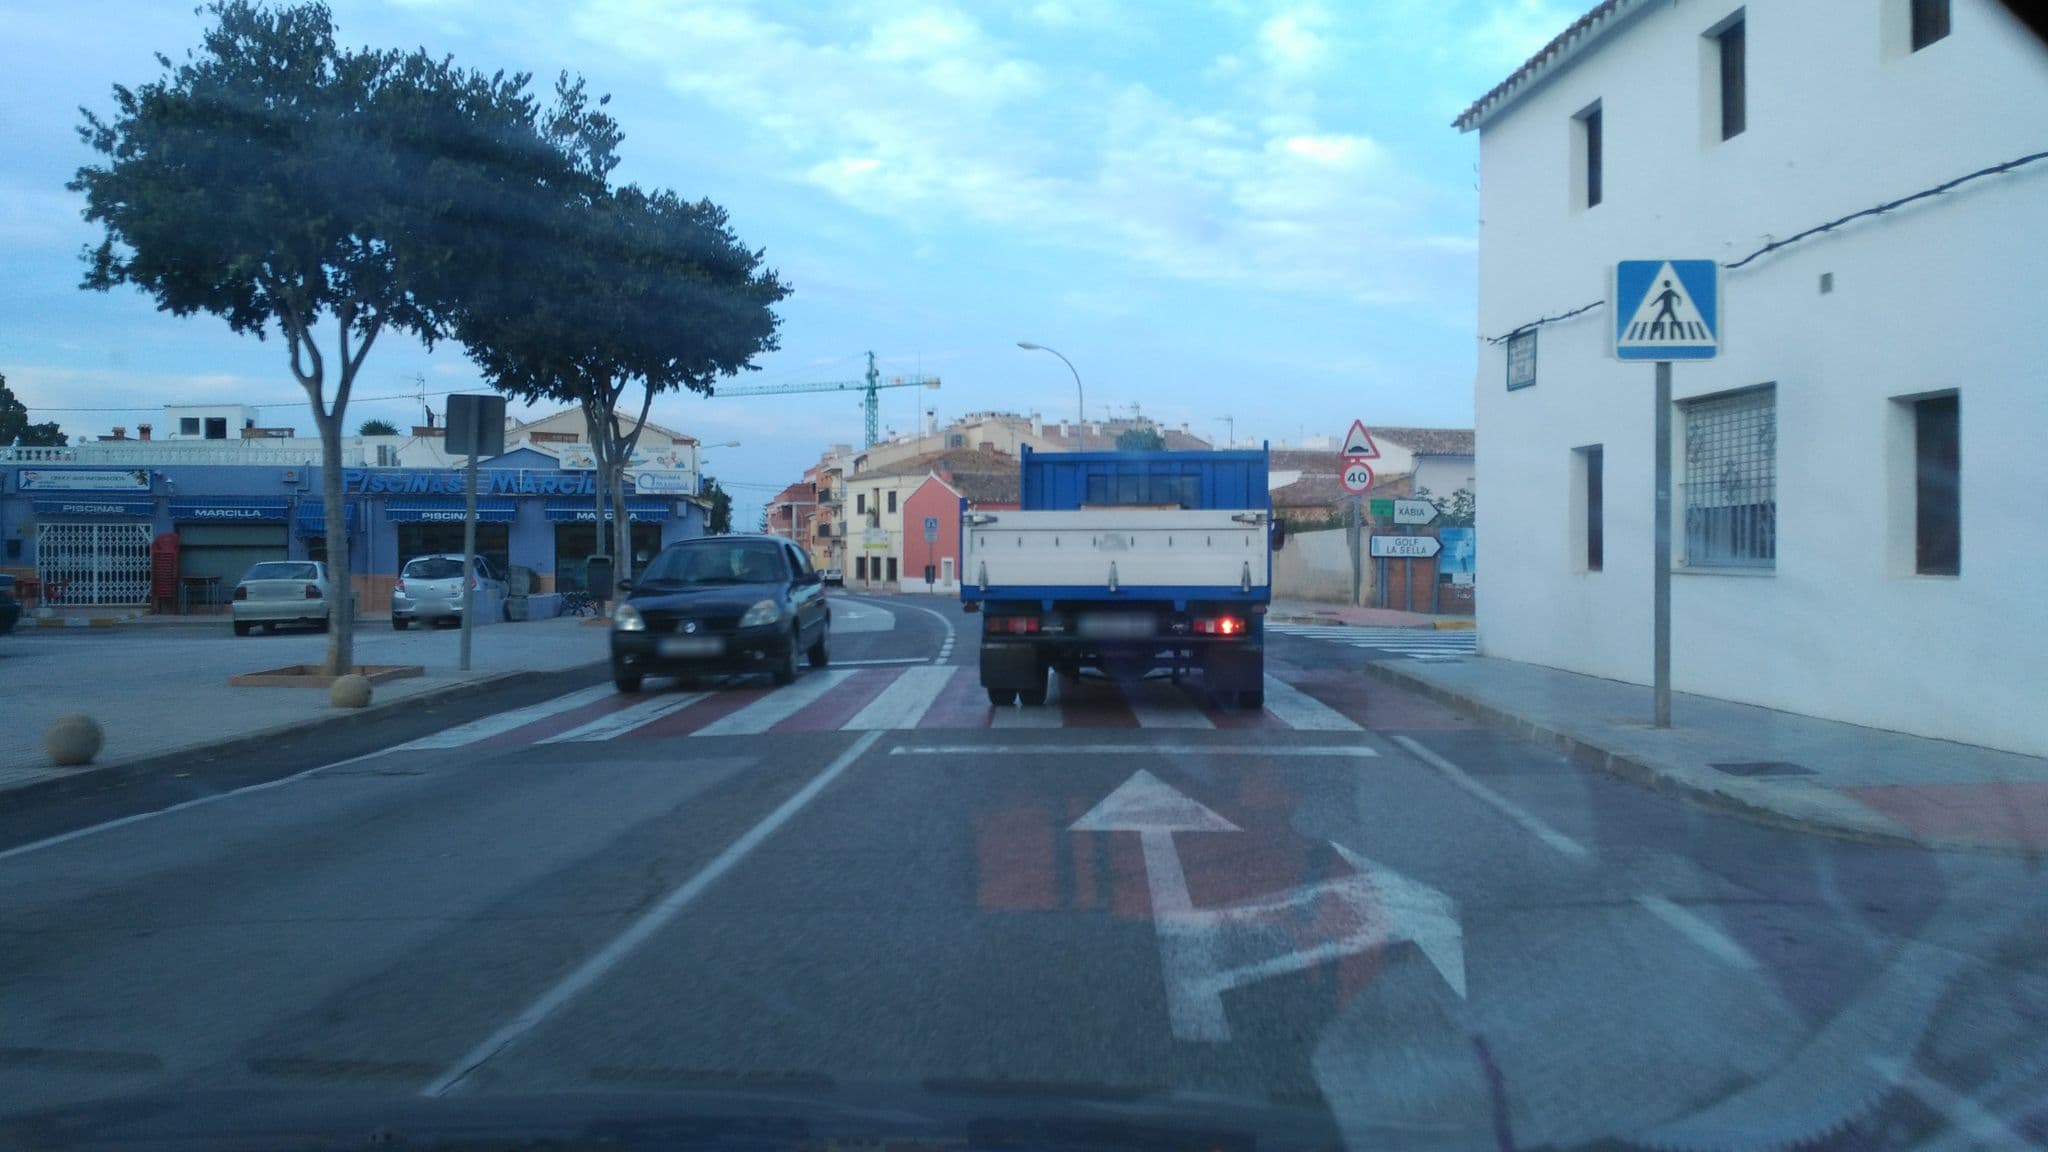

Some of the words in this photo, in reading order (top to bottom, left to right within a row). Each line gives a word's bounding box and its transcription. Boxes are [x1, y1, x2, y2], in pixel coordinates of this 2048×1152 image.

[341, 469, 465, 493] PISCINAS
[1347, 472, 1367, 483] 40
[62, 504, 125, 513] PISCINAS
[194, 508, 262, 517] MARCILLA
[576, 512, 638, 521] MACA
[1395, 538, 1419, 547] GOLF
[1386, 546, 1397, 554] LA
[1400, 546, 1427, 555] SELLA
